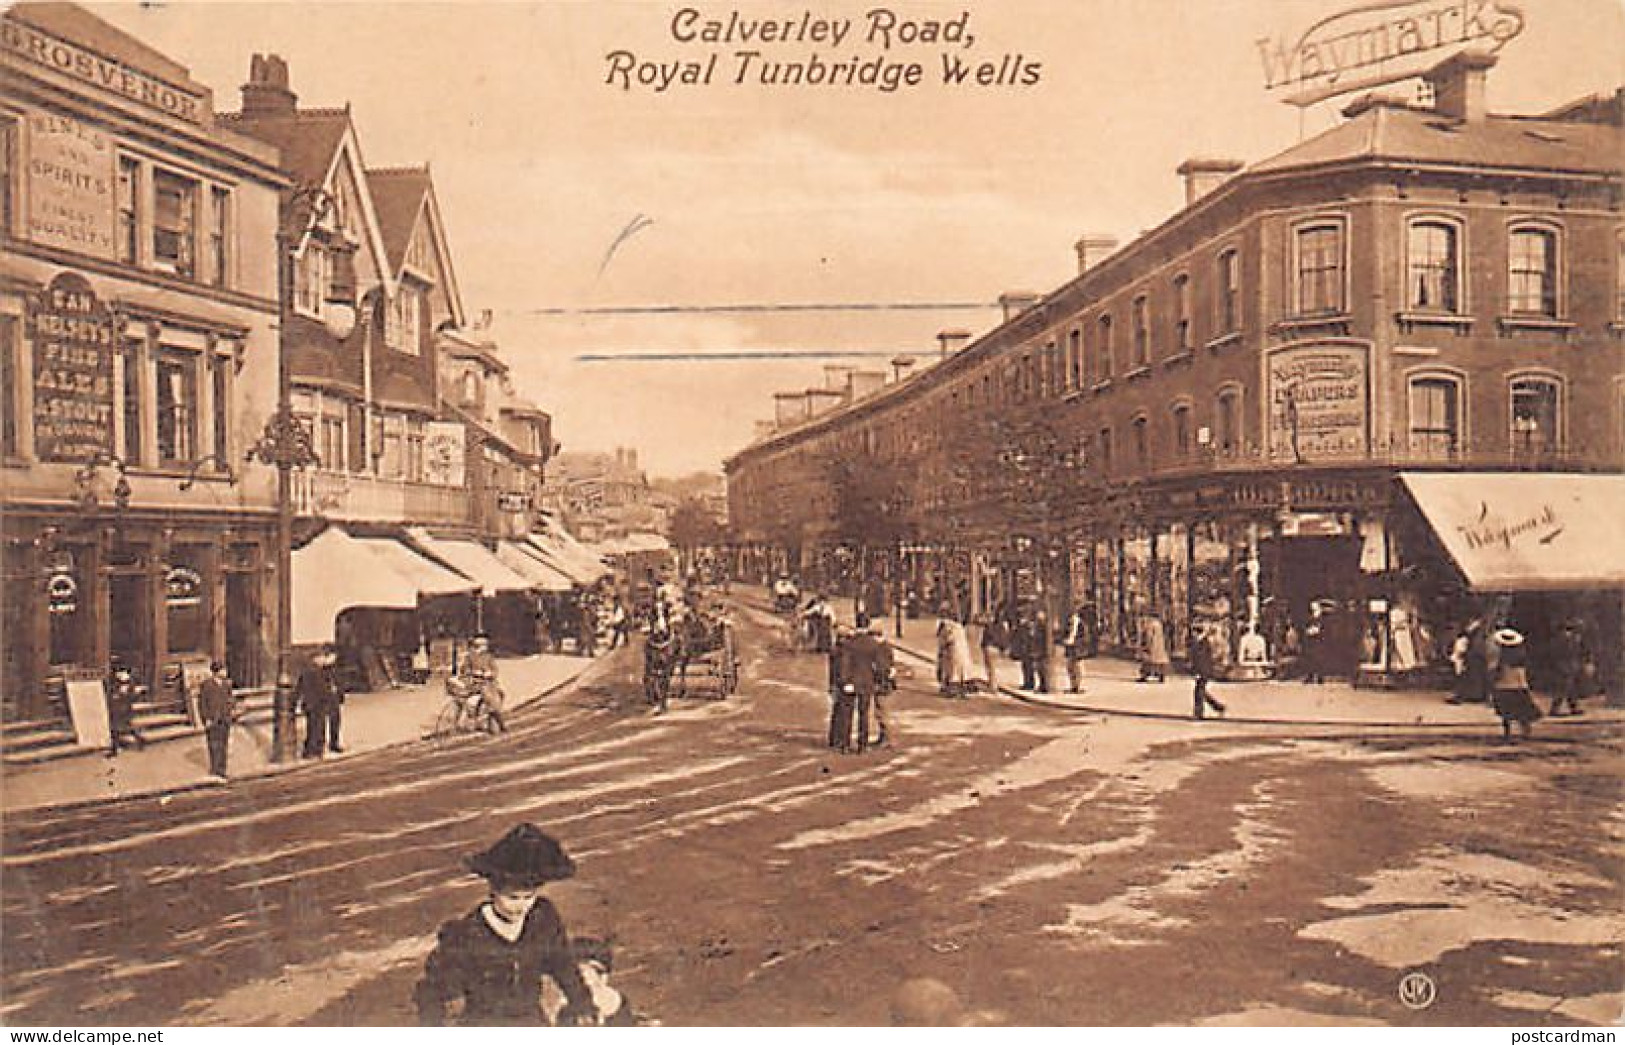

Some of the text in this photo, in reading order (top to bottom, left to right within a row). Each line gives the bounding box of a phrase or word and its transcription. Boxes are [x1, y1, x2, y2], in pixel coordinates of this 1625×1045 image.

[2, 24, 197, 113] GROSVENOR
[31, 157, 107, 195] SPIRITS
[36, 368, 108, 396] ALES
